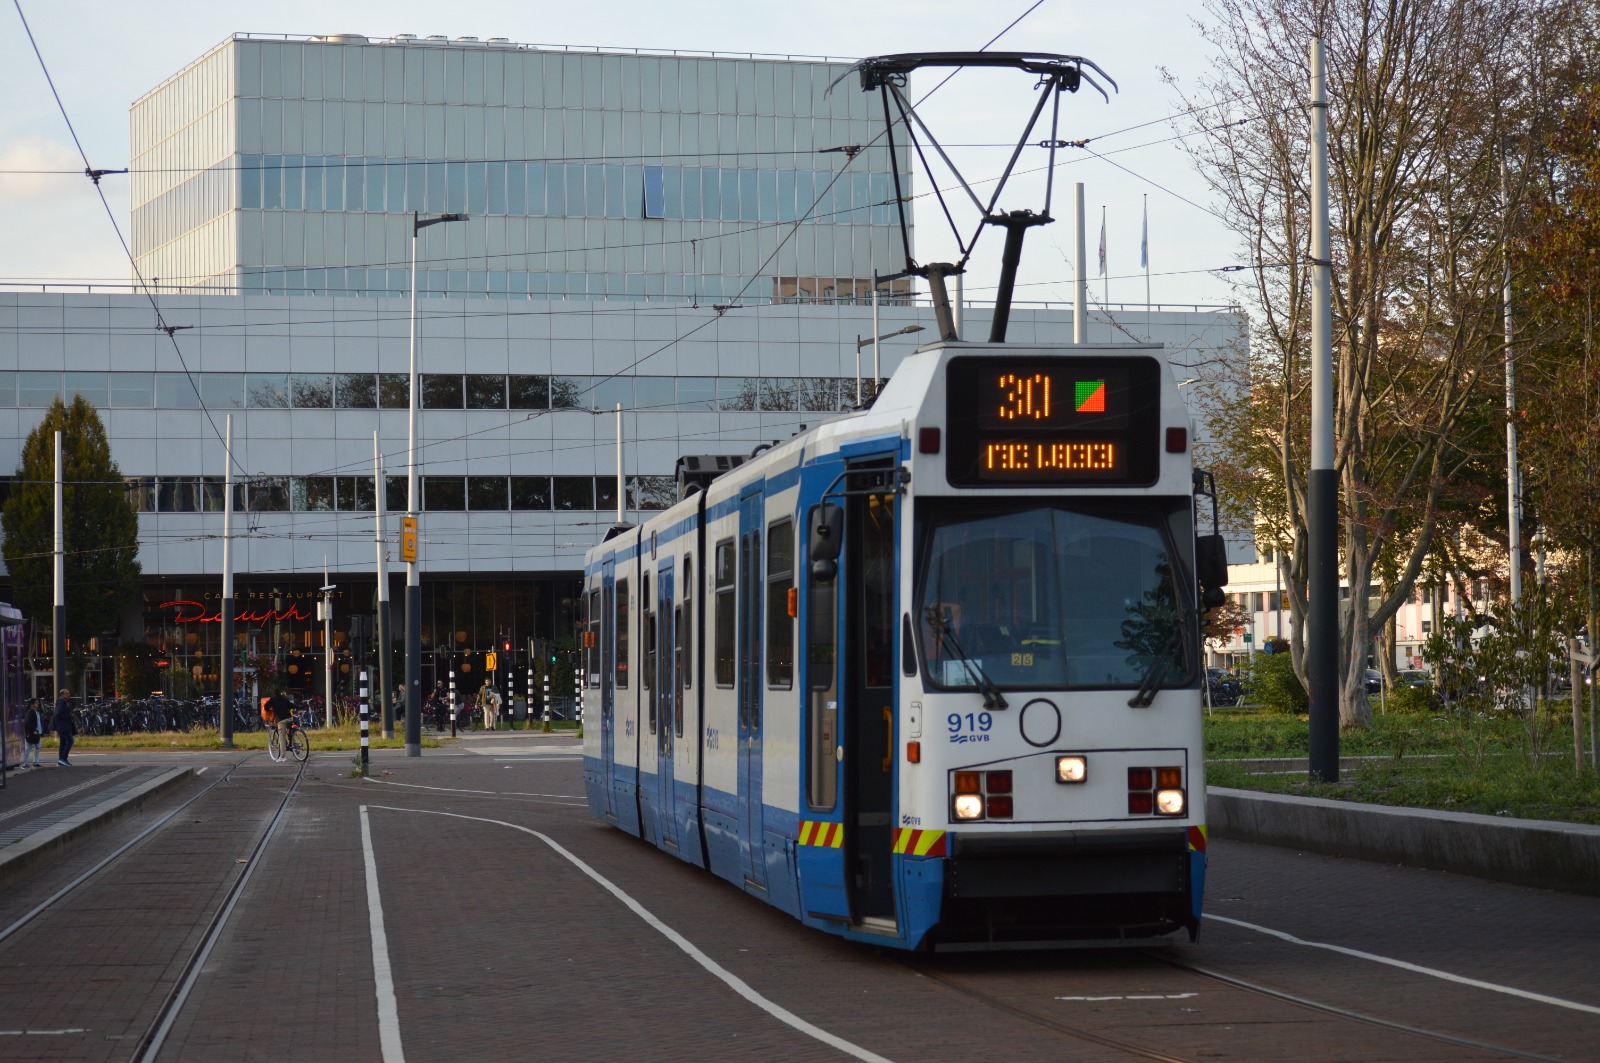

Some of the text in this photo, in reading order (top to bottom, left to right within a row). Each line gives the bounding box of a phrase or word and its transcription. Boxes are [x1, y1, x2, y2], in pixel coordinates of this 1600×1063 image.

[1000, 374, 1050, 419] 30
[947, 711, 993, 733] 919
[969, 734, 990, 743] GVB
